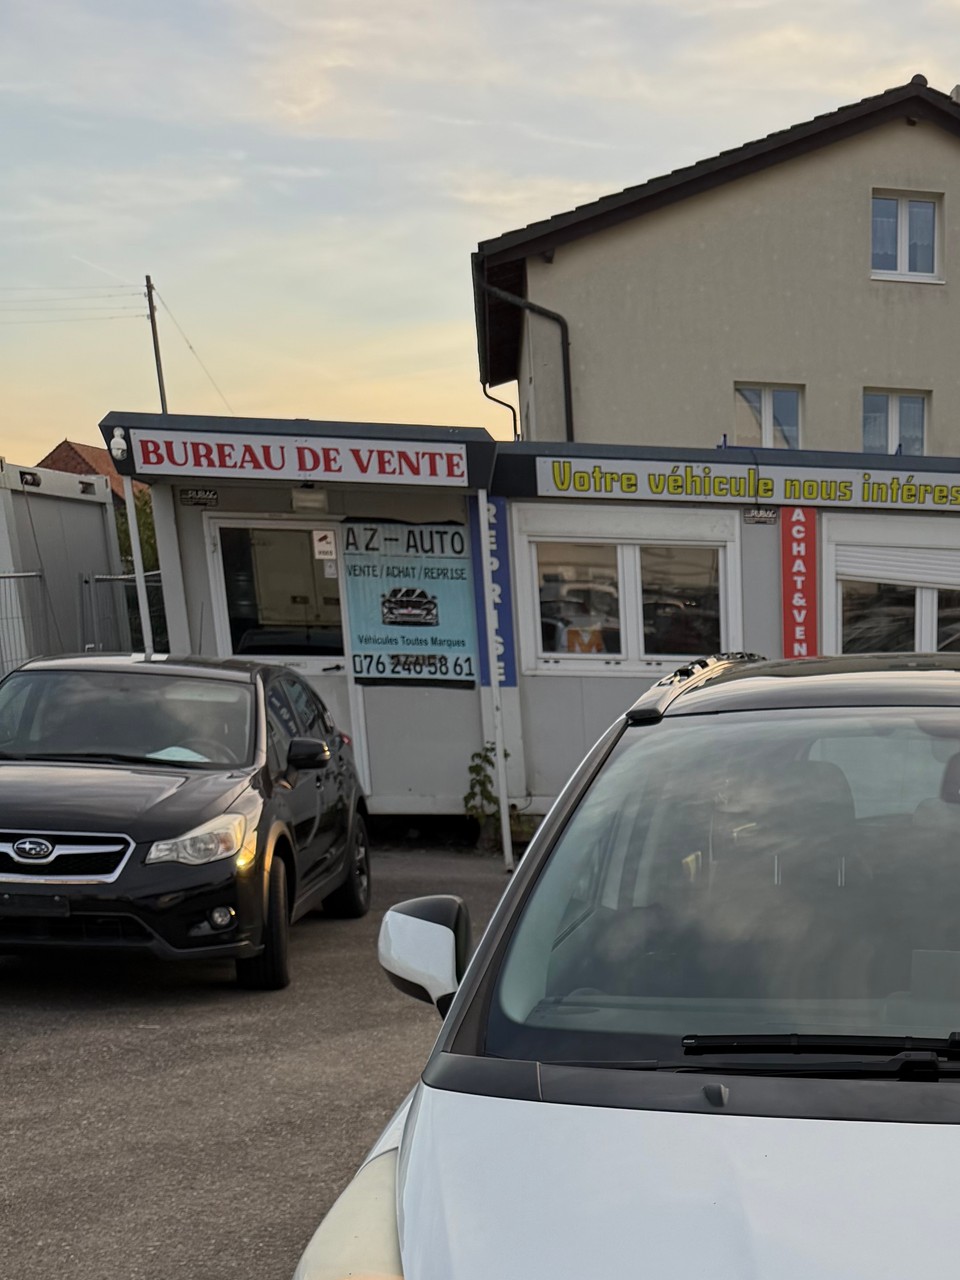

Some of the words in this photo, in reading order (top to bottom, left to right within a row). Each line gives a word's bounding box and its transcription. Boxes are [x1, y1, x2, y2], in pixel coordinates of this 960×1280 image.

[139, 439, 285, 471] BUREAU
[296, 446, 342, 473] DE
[349, 448, 465, 478] VENTE
[552, 460, 638, 494] Votre
[648, 465, 774, 499] véhicule
[784, 477, 853, 501] nous
[358, 635, 399, 646] Véhicules
[401, 635, 429, 647] Toutes
[431, 636, 466, 649] Marques
[353, 654, 386, 674] 076
[453, 656, 475, 677] 61
